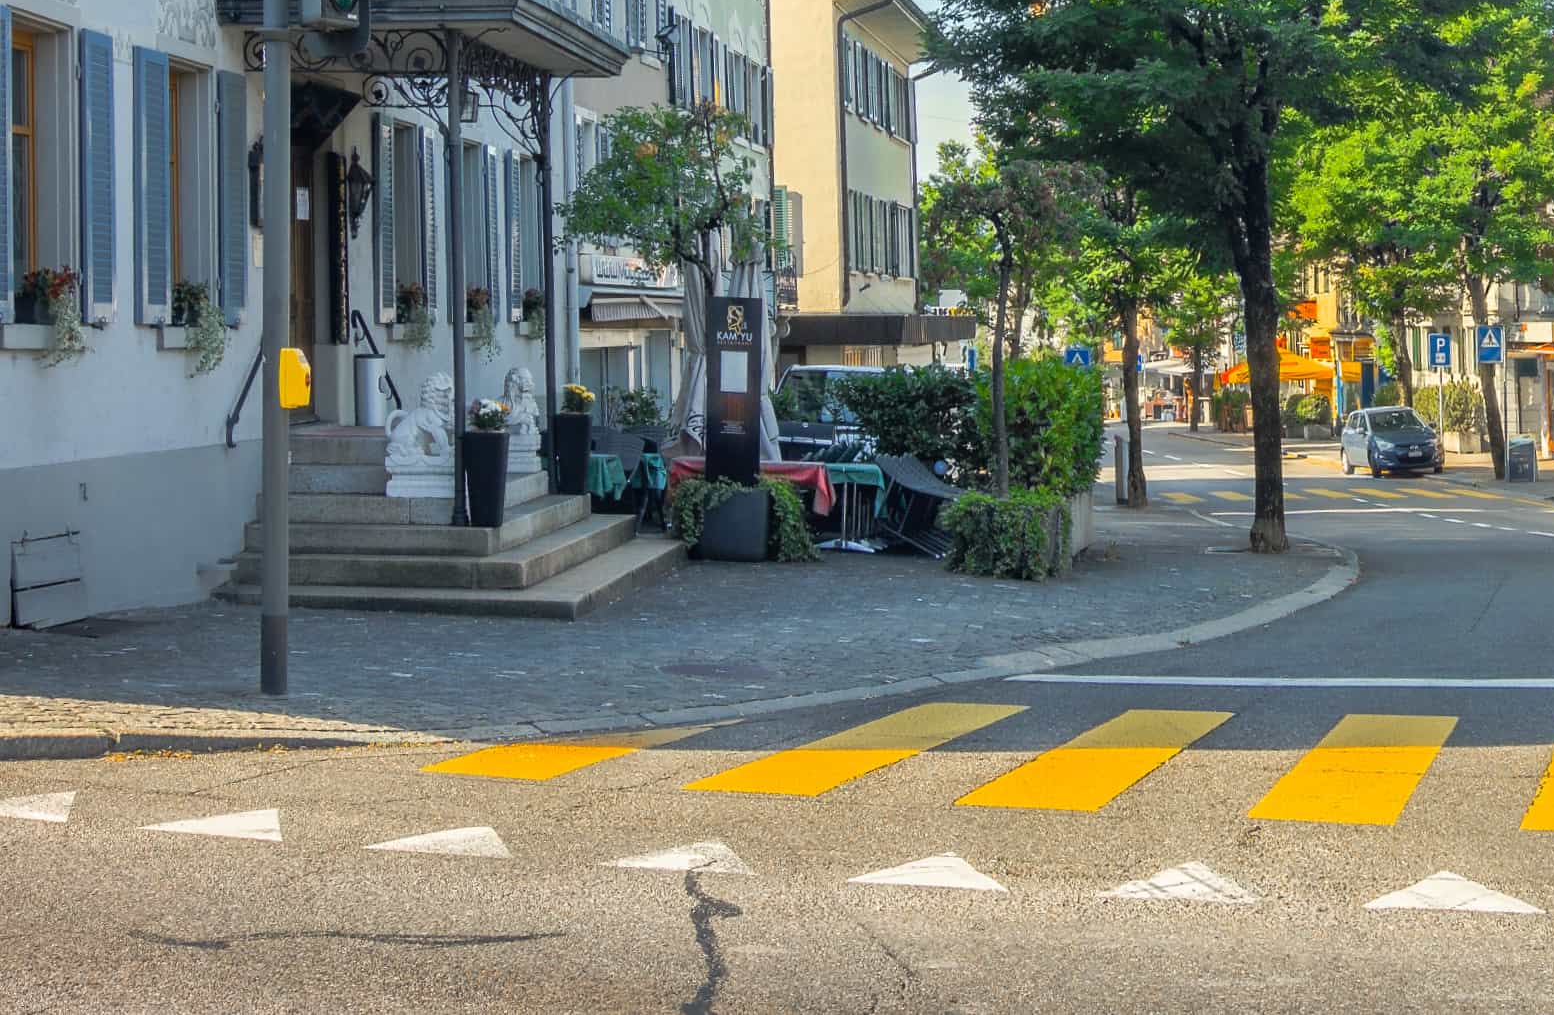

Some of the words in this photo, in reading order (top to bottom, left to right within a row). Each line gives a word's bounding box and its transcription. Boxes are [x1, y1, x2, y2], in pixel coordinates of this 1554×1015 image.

[717, 331, 737, 342] KAM
[740, 332, 753, 343] YU
[1437, 337, 1446, 352] P
